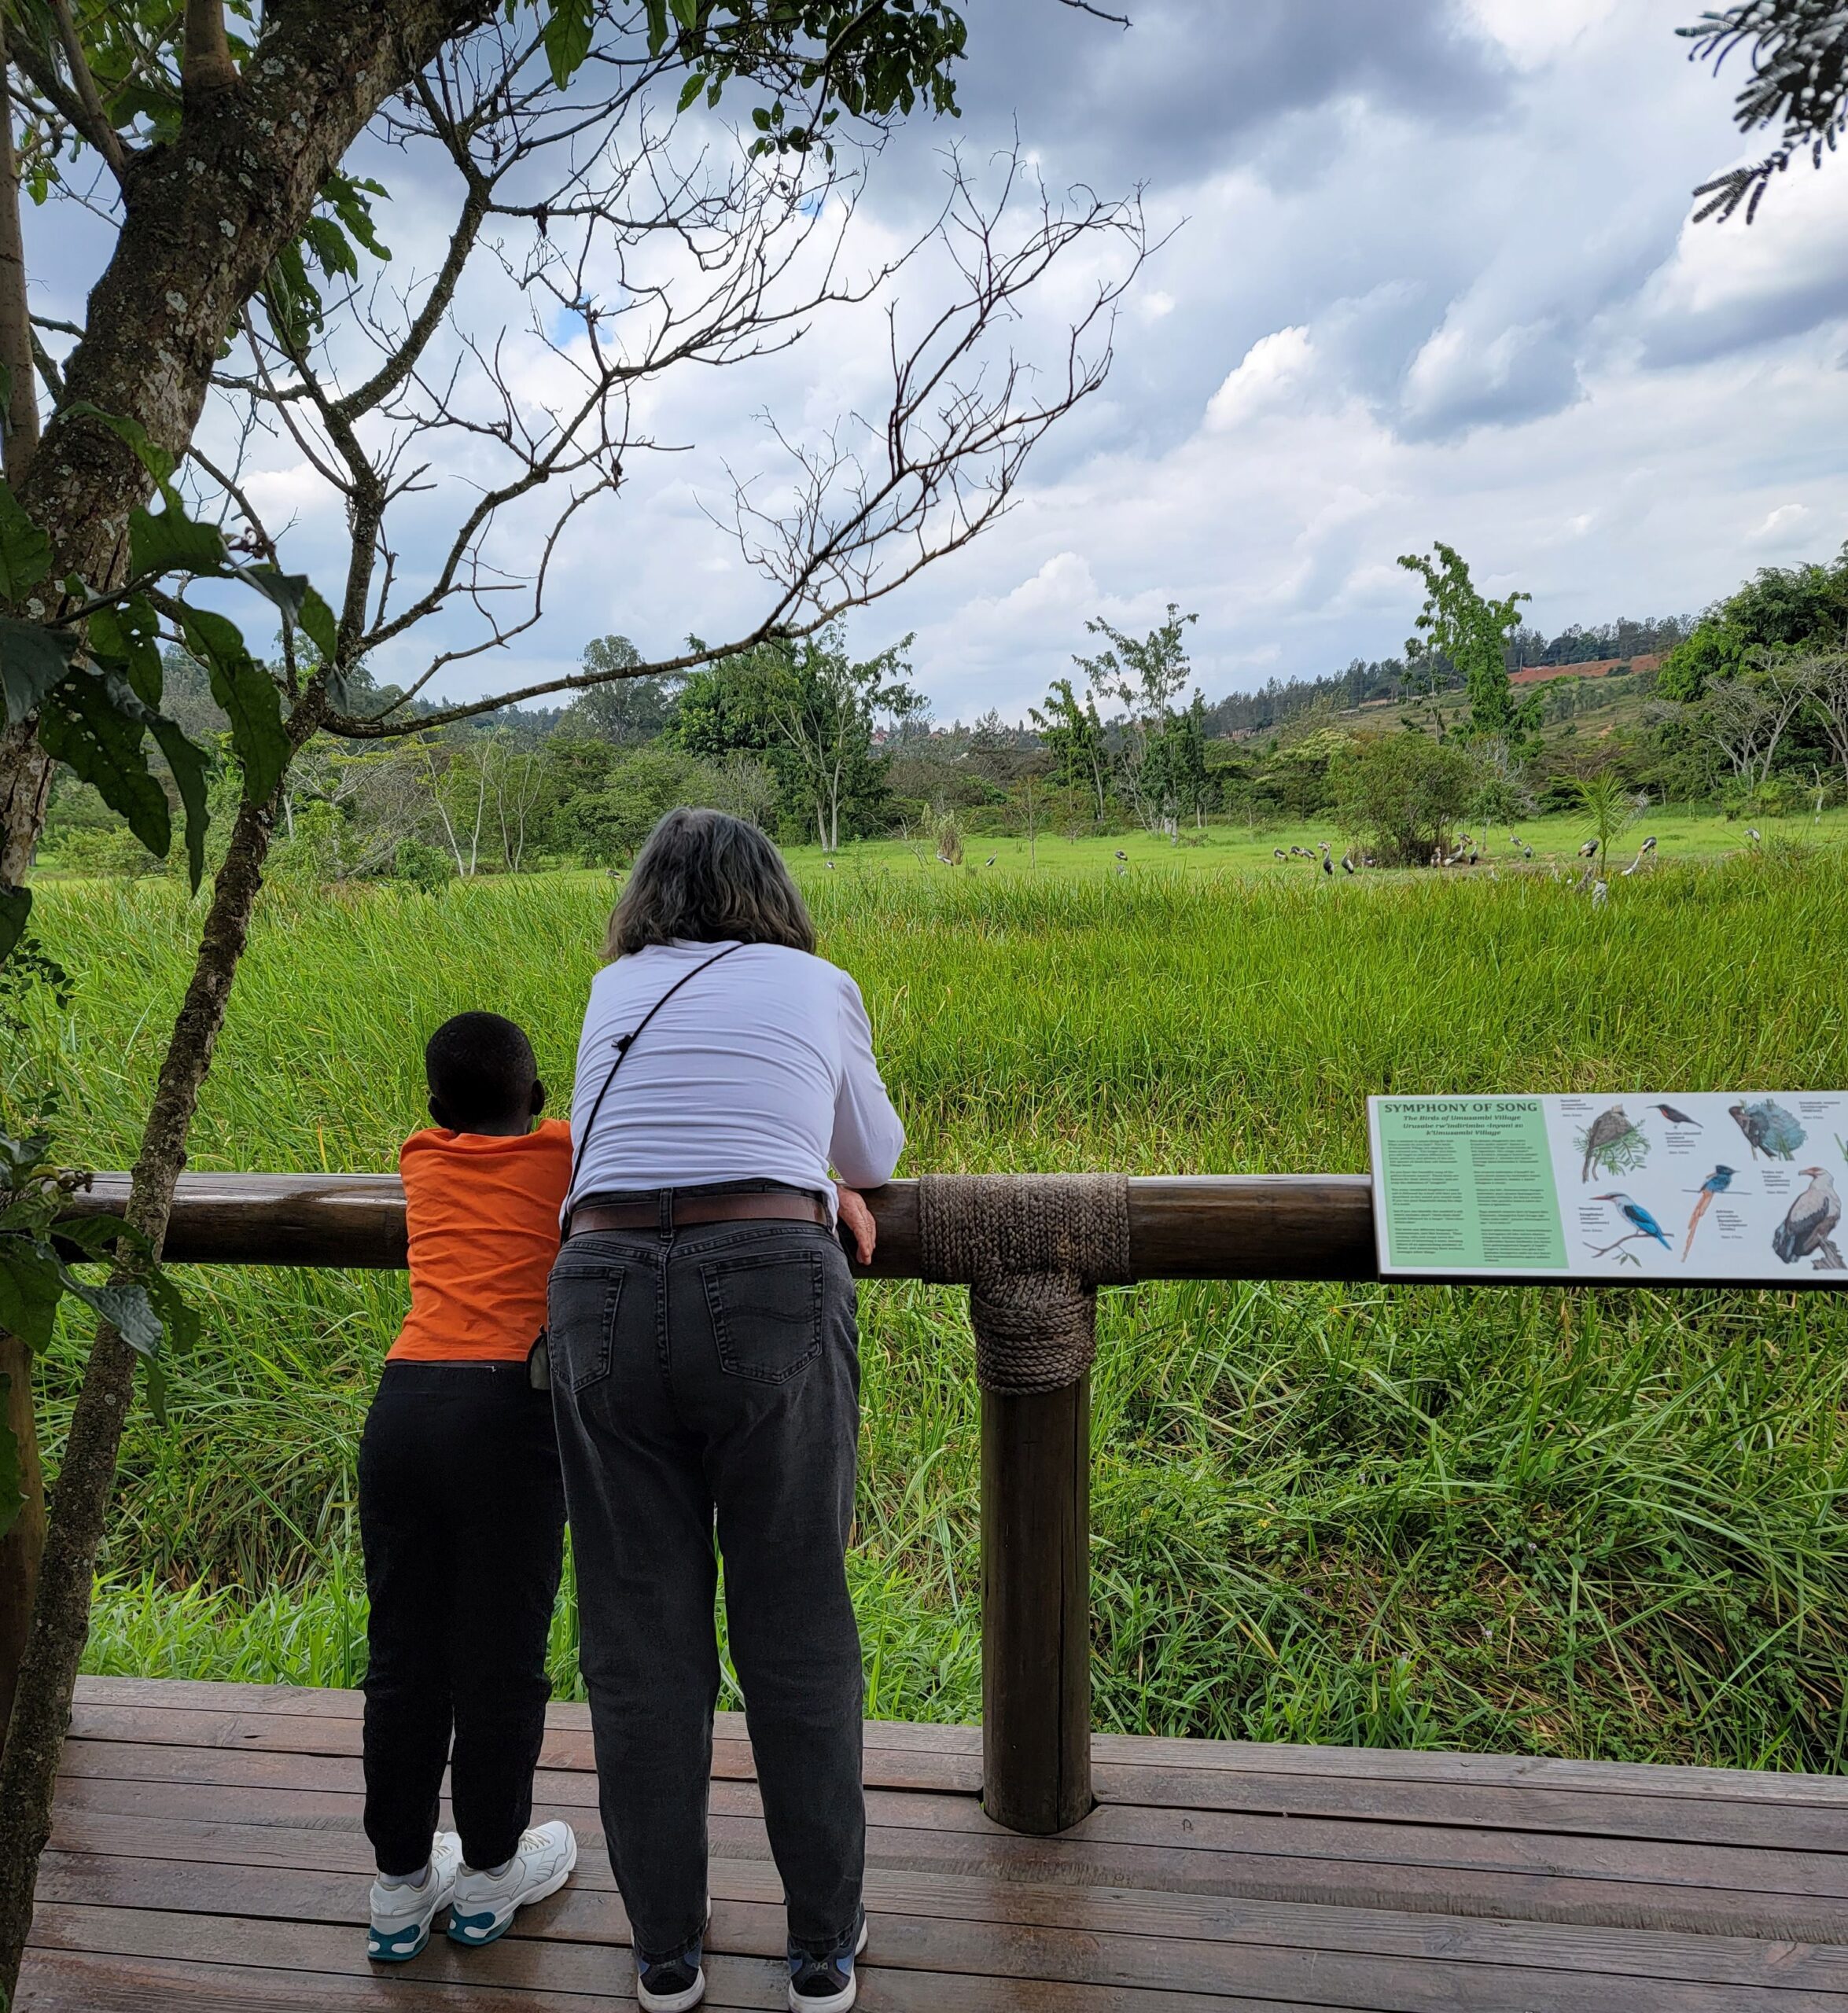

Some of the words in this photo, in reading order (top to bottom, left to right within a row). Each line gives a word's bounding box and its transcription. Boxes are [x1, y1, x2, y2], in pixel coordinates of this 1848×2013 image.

[1385, 1103, 1469, 1113] SYMPHONY
[1473, 1103, 1493, 1112] OF
[1496, 1102, 1537, 1112] SONG
